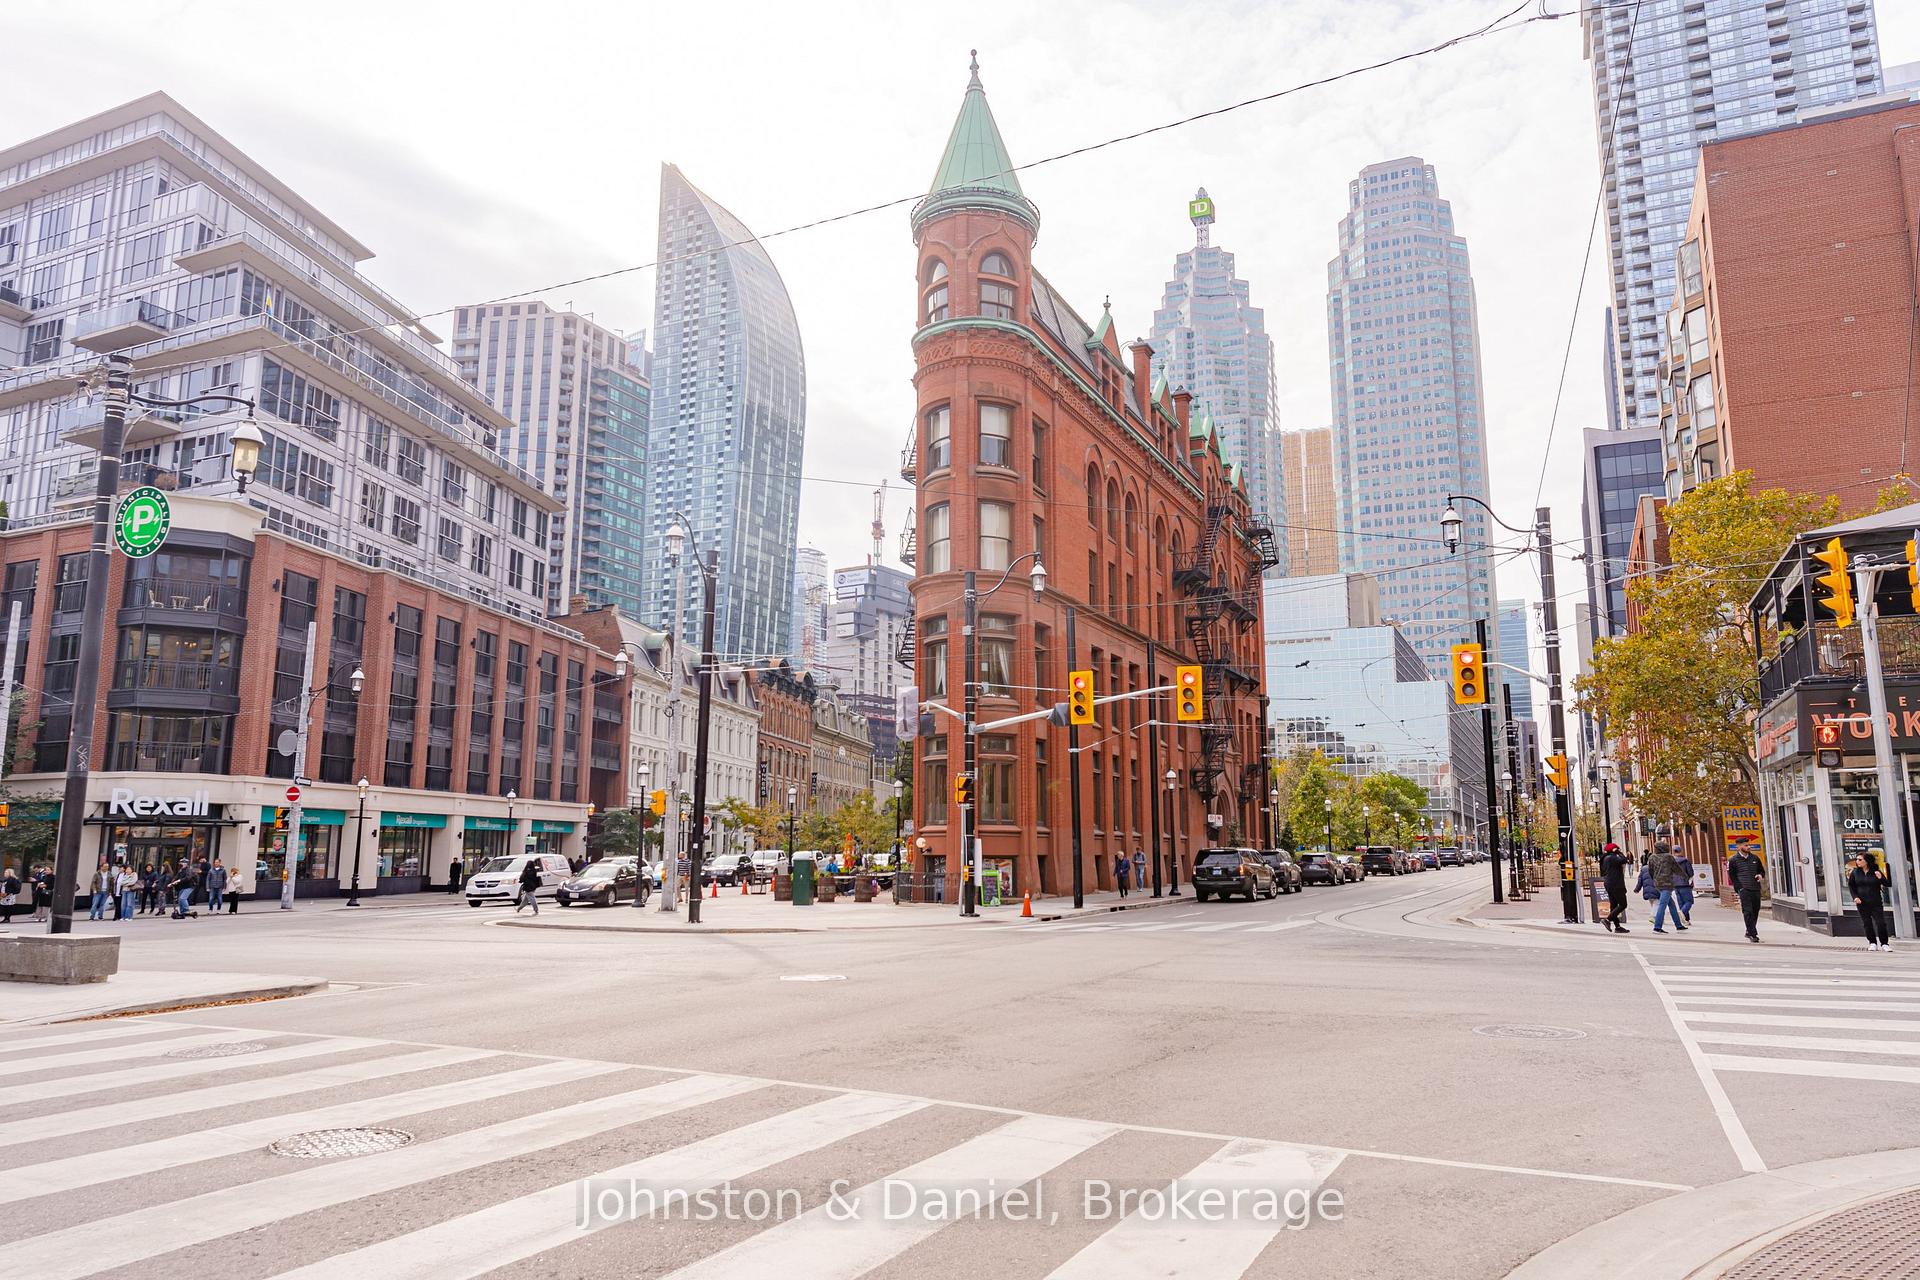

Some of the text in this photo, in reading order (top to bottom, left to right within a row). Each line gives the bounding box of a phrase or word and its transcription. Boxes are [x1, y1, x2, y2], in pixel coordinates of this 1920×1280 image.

[1192, 202, 1207, 213] TD
[117, 490, 168, 522] MUNICIPAL
[132, 505, 154, 533] P
[117, 526, 167, 555] PARKING
[1848, 696, 1907, 708] TE
[109, 787, 209, 818] Rexall
[1724, 807, 1757, 818] PARK
[1726, 820, 1759, 831] HERE
[1844, 818, 1873, 829] OPEN
